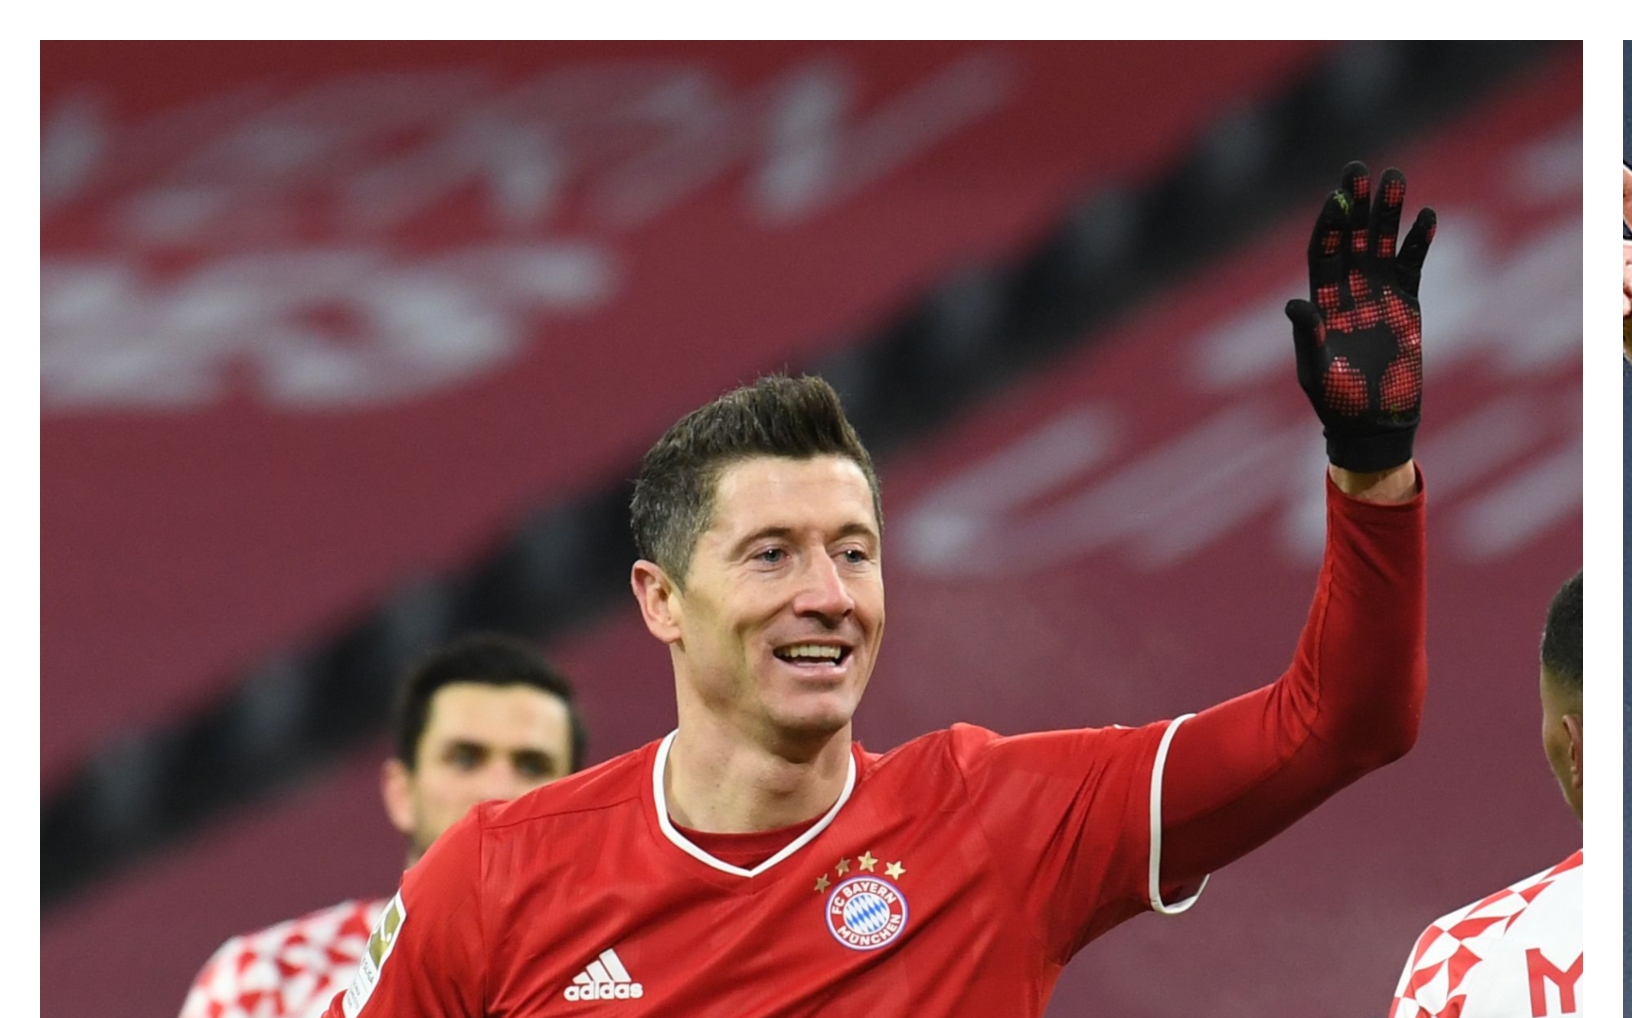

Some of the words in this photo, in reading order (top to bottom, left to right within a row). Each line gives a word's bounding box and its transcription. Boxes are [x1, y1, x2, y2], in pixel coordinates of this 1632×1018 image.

[831, 896, 846, 915] FC
[841, 881, 897, 905] BAYERN
[563, 981, 644, 1002] adidas
